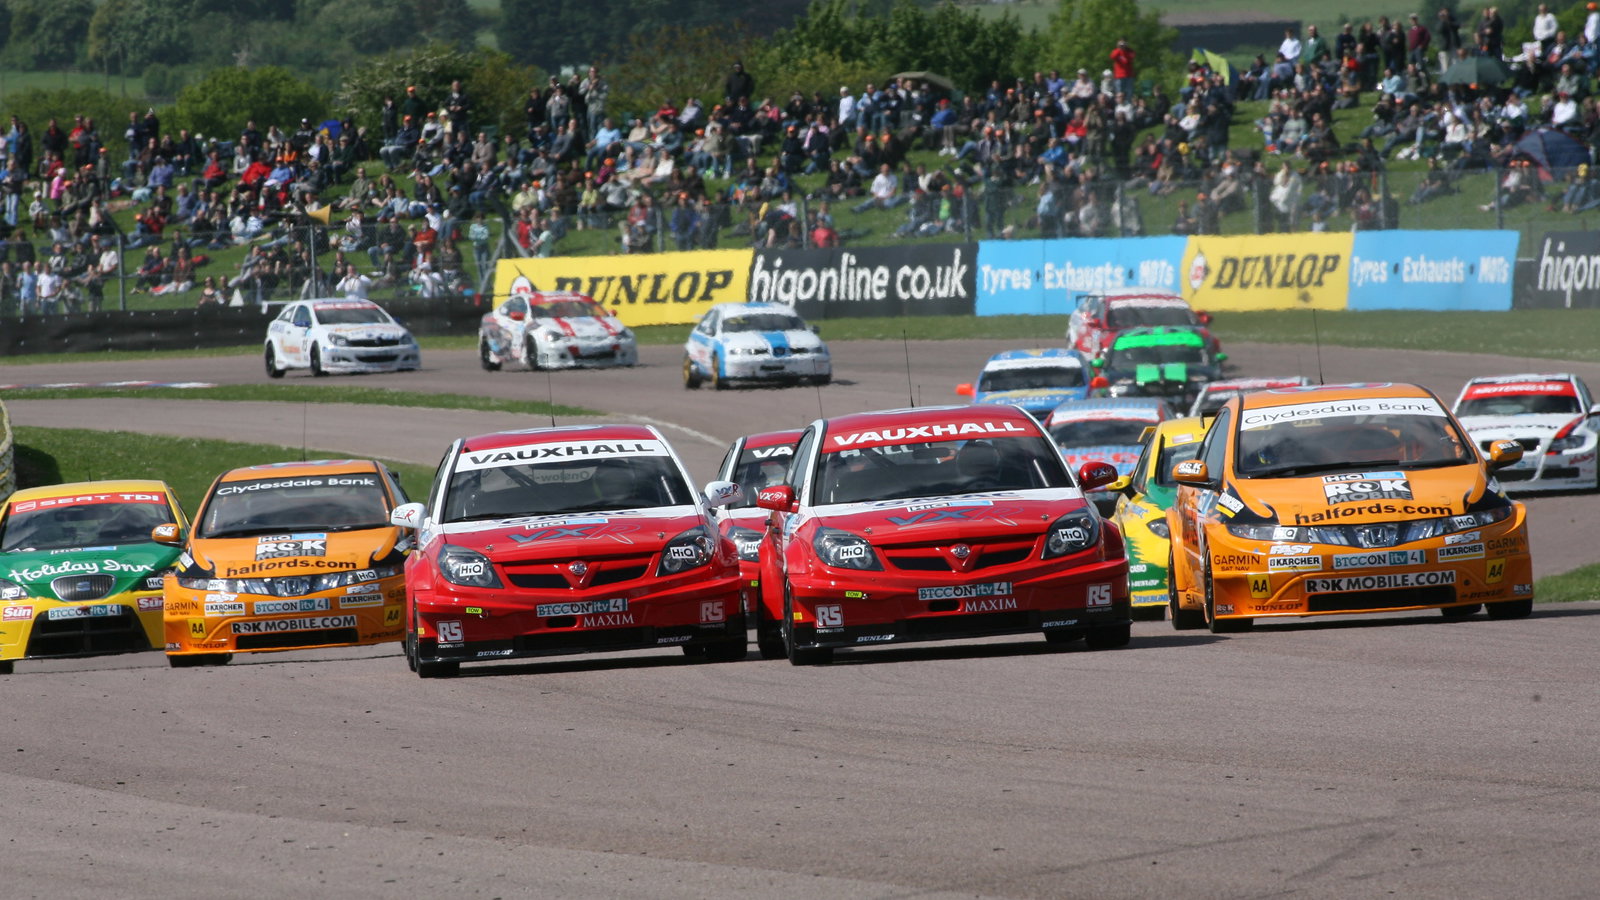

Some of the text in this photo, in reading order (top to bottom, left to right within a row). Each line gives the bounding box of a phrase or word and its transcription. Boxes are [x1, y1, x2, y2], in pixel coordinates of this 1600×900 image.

[981, 259, 1175, 295] Tyres Exhausts MOTs
[1212, 253, 1341, 290] DUNLOP
[1352, 254, 1510, 288] Tyres Exhausts MOTs
[1245, 403, 1371, 425] Clydesdale
[1379, 401, 1435, 413] Bank
[833, 422, 1025, 446] VAUXHALL
[469, 443, 655, 465] VAUXHALL
[217, 478, 375, 496] Clydesdale Bank
[39, 494, 160, 507] SEAT TDI
[1329, 491, 1413, 506] MOBILE
[1294, 503, 1453, 525] halfords.com
[1456, 517, 1475, 527] HiQ
[1061, 529, 1082, 540] HiQ
[257, 549, 326, 561] MOBILE
[672, 547, 694, 559] HiQ
[841, 546, 863, 557] HiQ
[1213, 555, 1260, 565] GARMIN
[8, 559, 155, 583] Holiday Inn
[226, 558, 357, 577] halfords.com
[461, 564, 483, 575] HiQ
[1488, 564, 1503, 578] AA
[359, 571, 376, 579] HiQ
[1346, 571, 1455, 591] MOBILE.COM
[1252, 580, 1268, 592] AA
[1088, 585, 1111, 606] RS
[165, 601, 199, 611] GARMIN
[702, 602, 724, 622] RS
[965, 598, 1018, 612] MAXIM
[1254, 603, 1303, 611] DUNLOP
[4, 607, 32, 618] Sun
[817, 606, 842, 626] RS
[264, 615, 356, 631] MOBILE.COM
[583, 613, 635, 628] MAXIM
[1042, 619, 1078, 628] DUNLOP
[192, 622, 204, 634] AA
[438, 622, 463, 642] RS
[657, 635, 692, 644] DUNLOP
[857, 634, 895, 643] DUNLOP
[477, 649, 513, 657] DUNLOP
